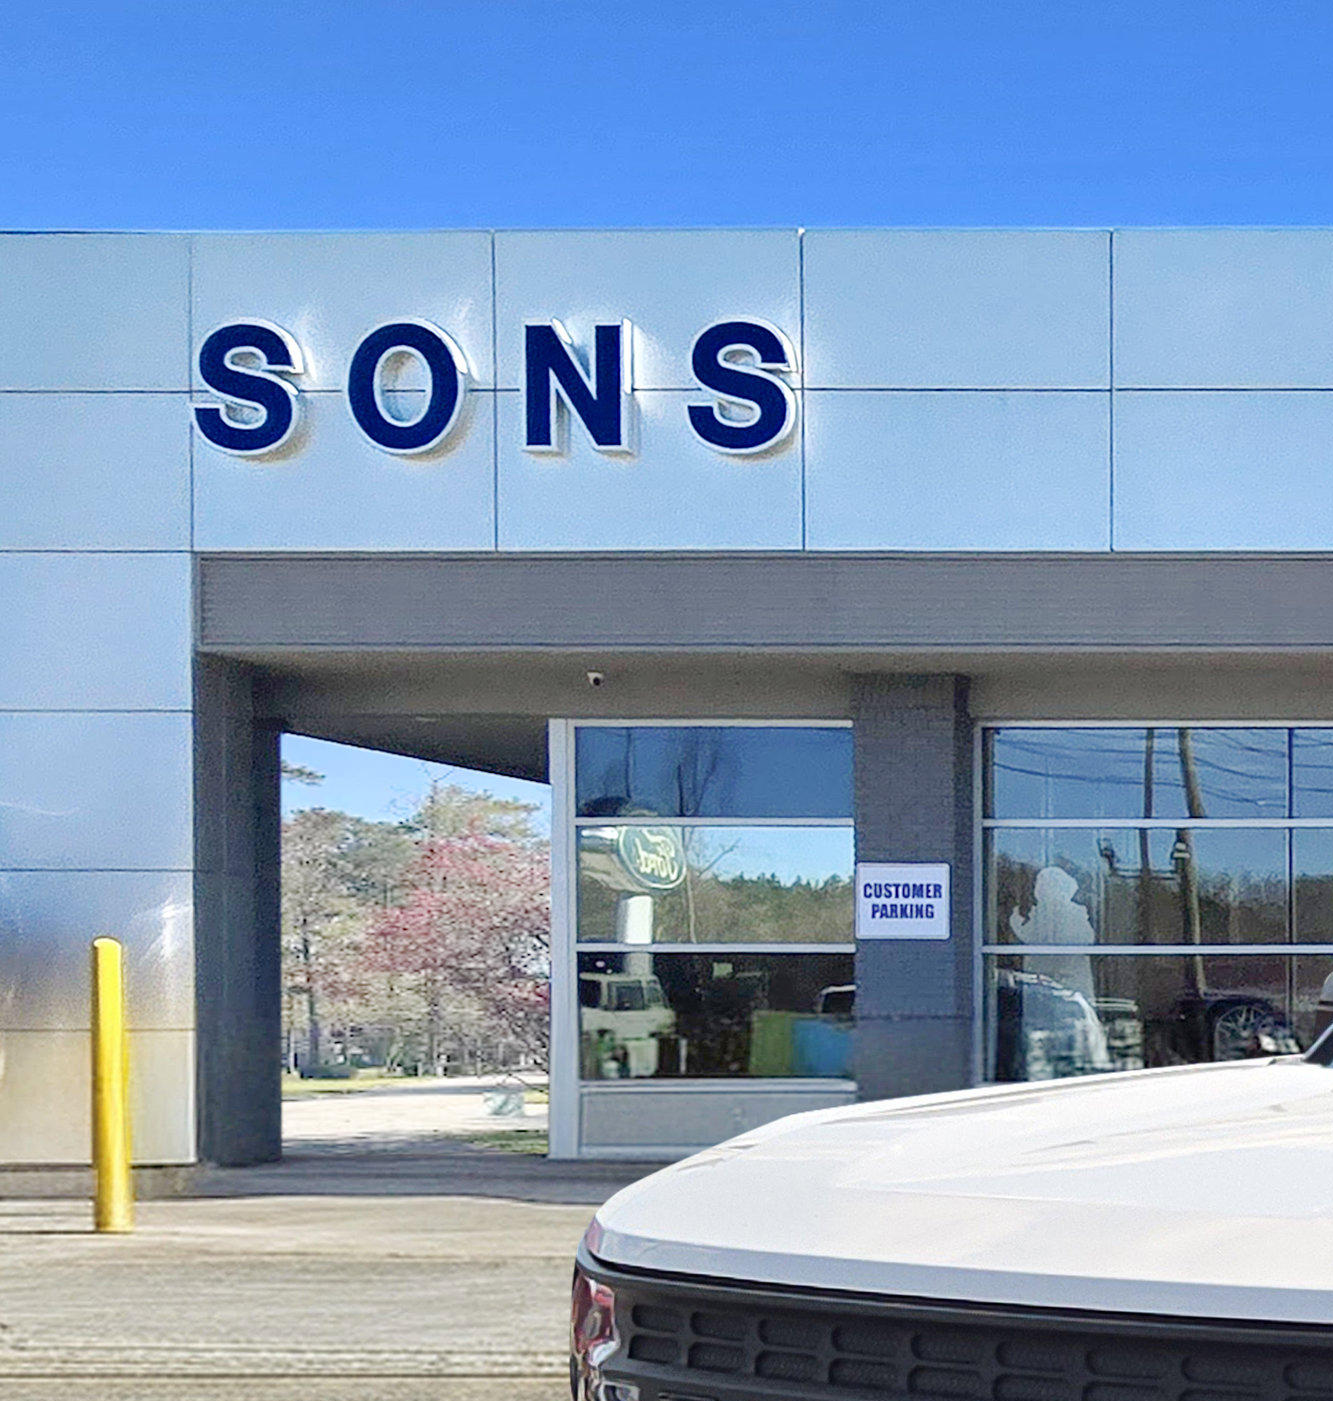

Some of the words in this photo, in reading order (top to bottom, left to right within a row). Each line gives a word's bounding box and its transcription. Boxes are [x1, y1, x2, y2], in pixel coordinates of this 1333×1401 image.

[193, 320, 797, 454] SONS
[863, 882, 943, 899] CUSTOMER
[871, 904, 935, 919] PARKING
